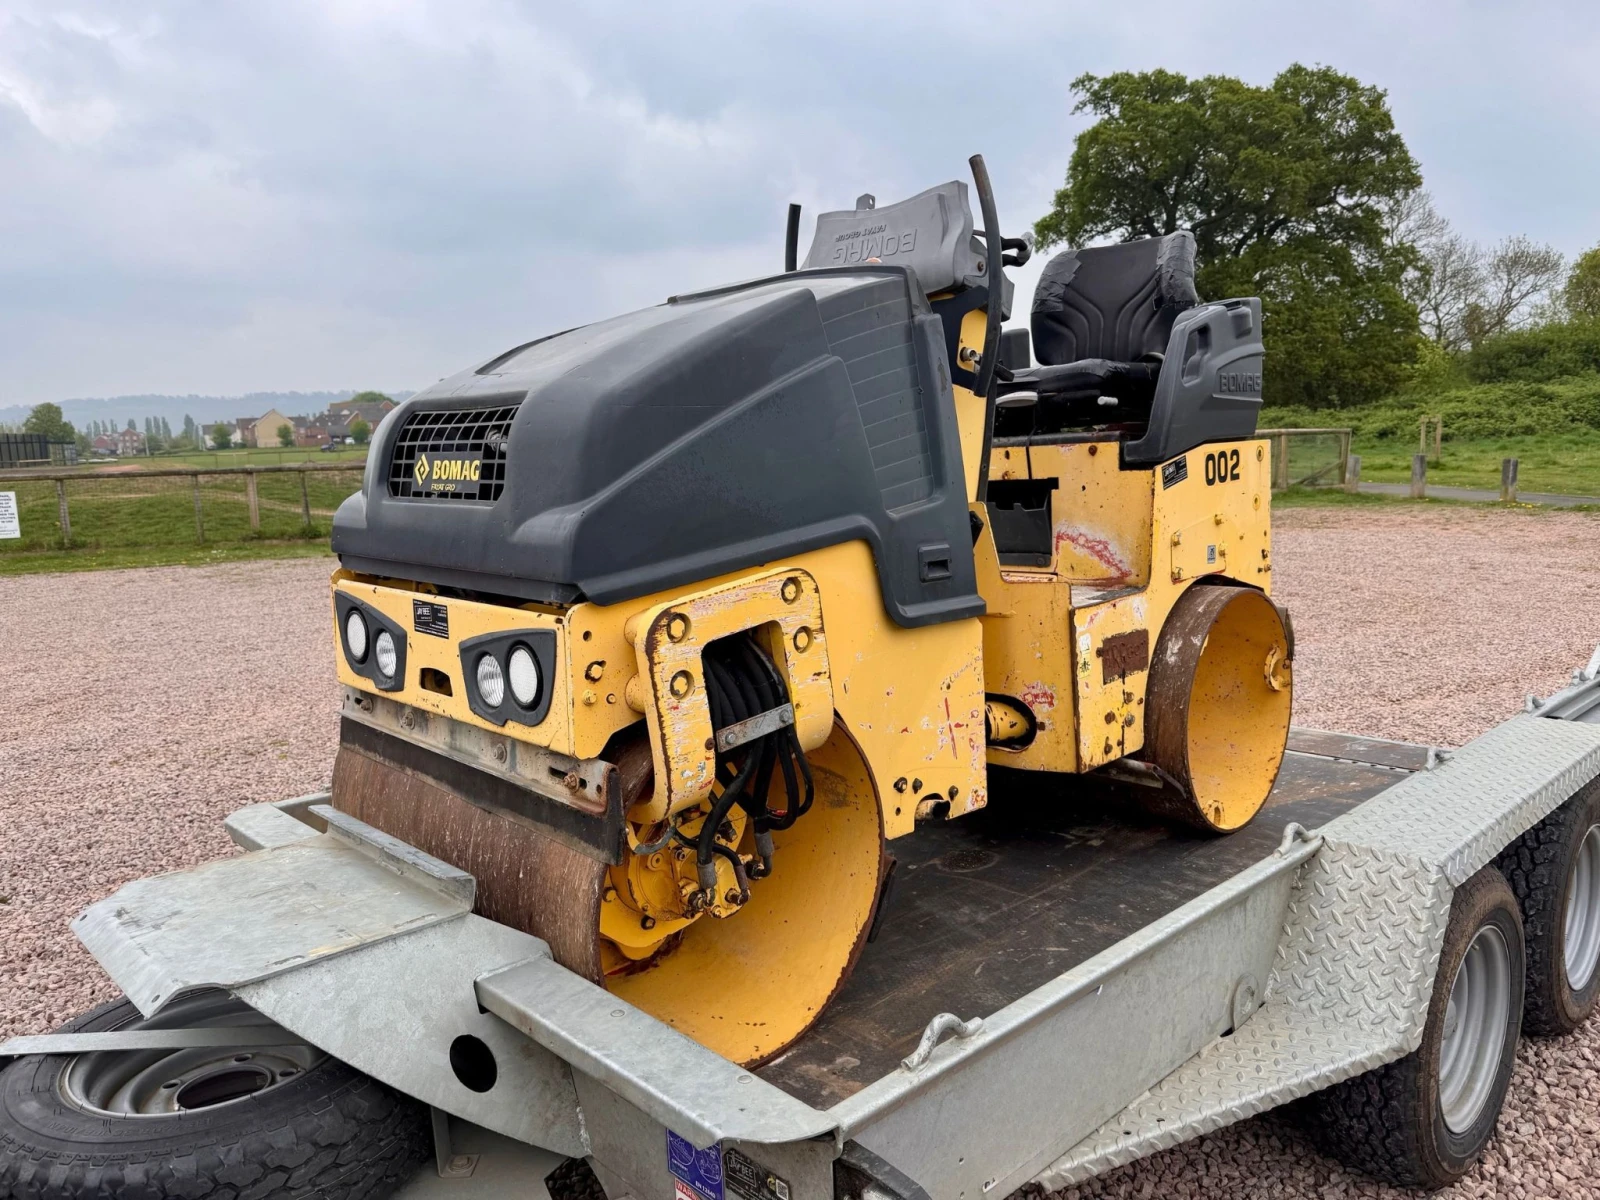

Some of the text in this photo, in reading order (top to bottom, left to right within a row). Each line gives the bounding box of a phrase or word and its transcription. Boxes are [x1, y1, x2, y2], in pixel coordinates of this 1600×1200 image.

[833, 229, 918, 264] BOMAG
[1219, 372, 1262, 393] BOMAG
[432, 459, 481, 482] BOMAG
[1204, 448, 1241, 487] 002
